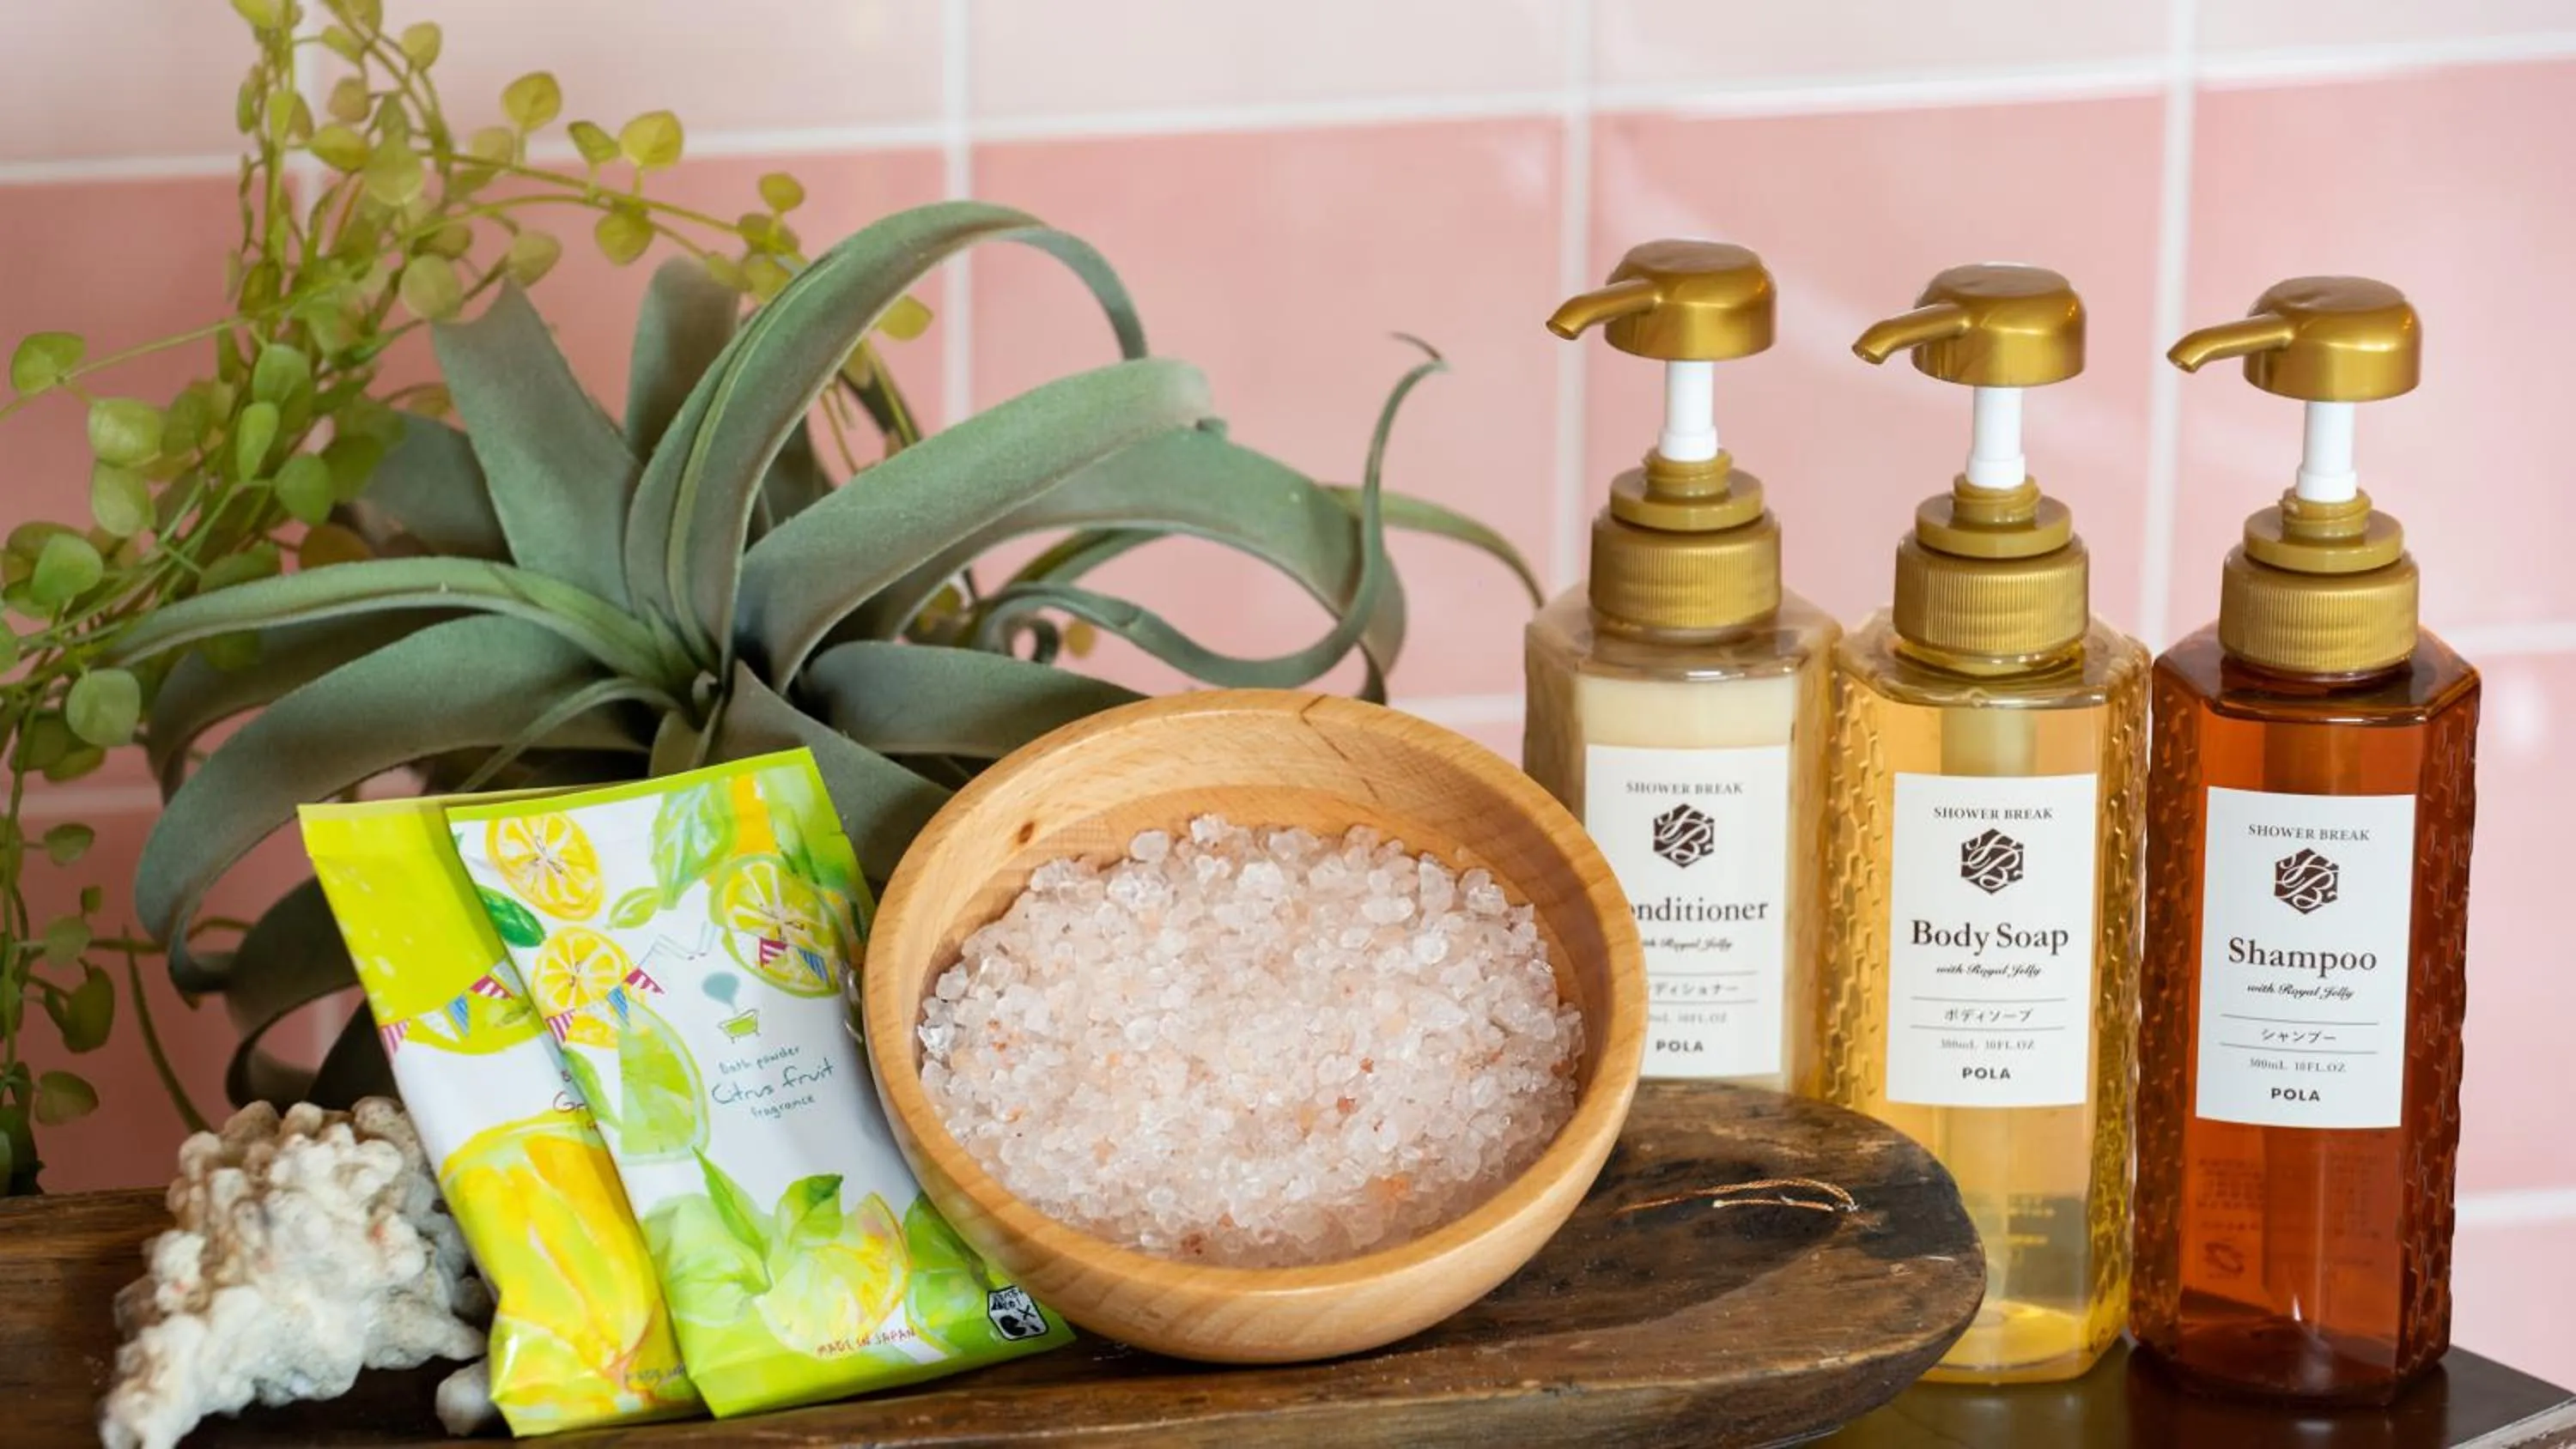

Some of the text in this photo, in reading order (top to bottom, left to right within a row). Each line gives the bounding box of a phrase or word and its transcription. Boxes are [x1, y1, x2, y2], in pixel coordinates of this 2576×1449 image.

[1625, 782, 1744, 795] SHOWER BREAK
[1934, 807, 2053, 820] SHOWER BREAK
[2248, 823, 2370, 840] SHOWER BREAK
[1631, 897, 1769, 921] nditioner
[1911, 919, 2069, 956] Body Soap
[2228, 937, 2378, 978] Shampoo
[1936, 963, 2042, 979] with Royal Jelly
[2246, 983, 2355, 1000] with Royal Jelly
[1944, 1008, 2033, 1022] ボディソープ
[2261, 1029, 2337, 1043] シャンプー
[1656, 1040, 1704, 1052] POLA
[756, 1046, 800, 1070] powder
[711, 1057, 835, 1105] Citrus fruit
[1961, 1067, 2011, 1080] POLA
[2270, 1088, 2322, 1101] POLA
[750, 1094, 816, 1119] fragrance
